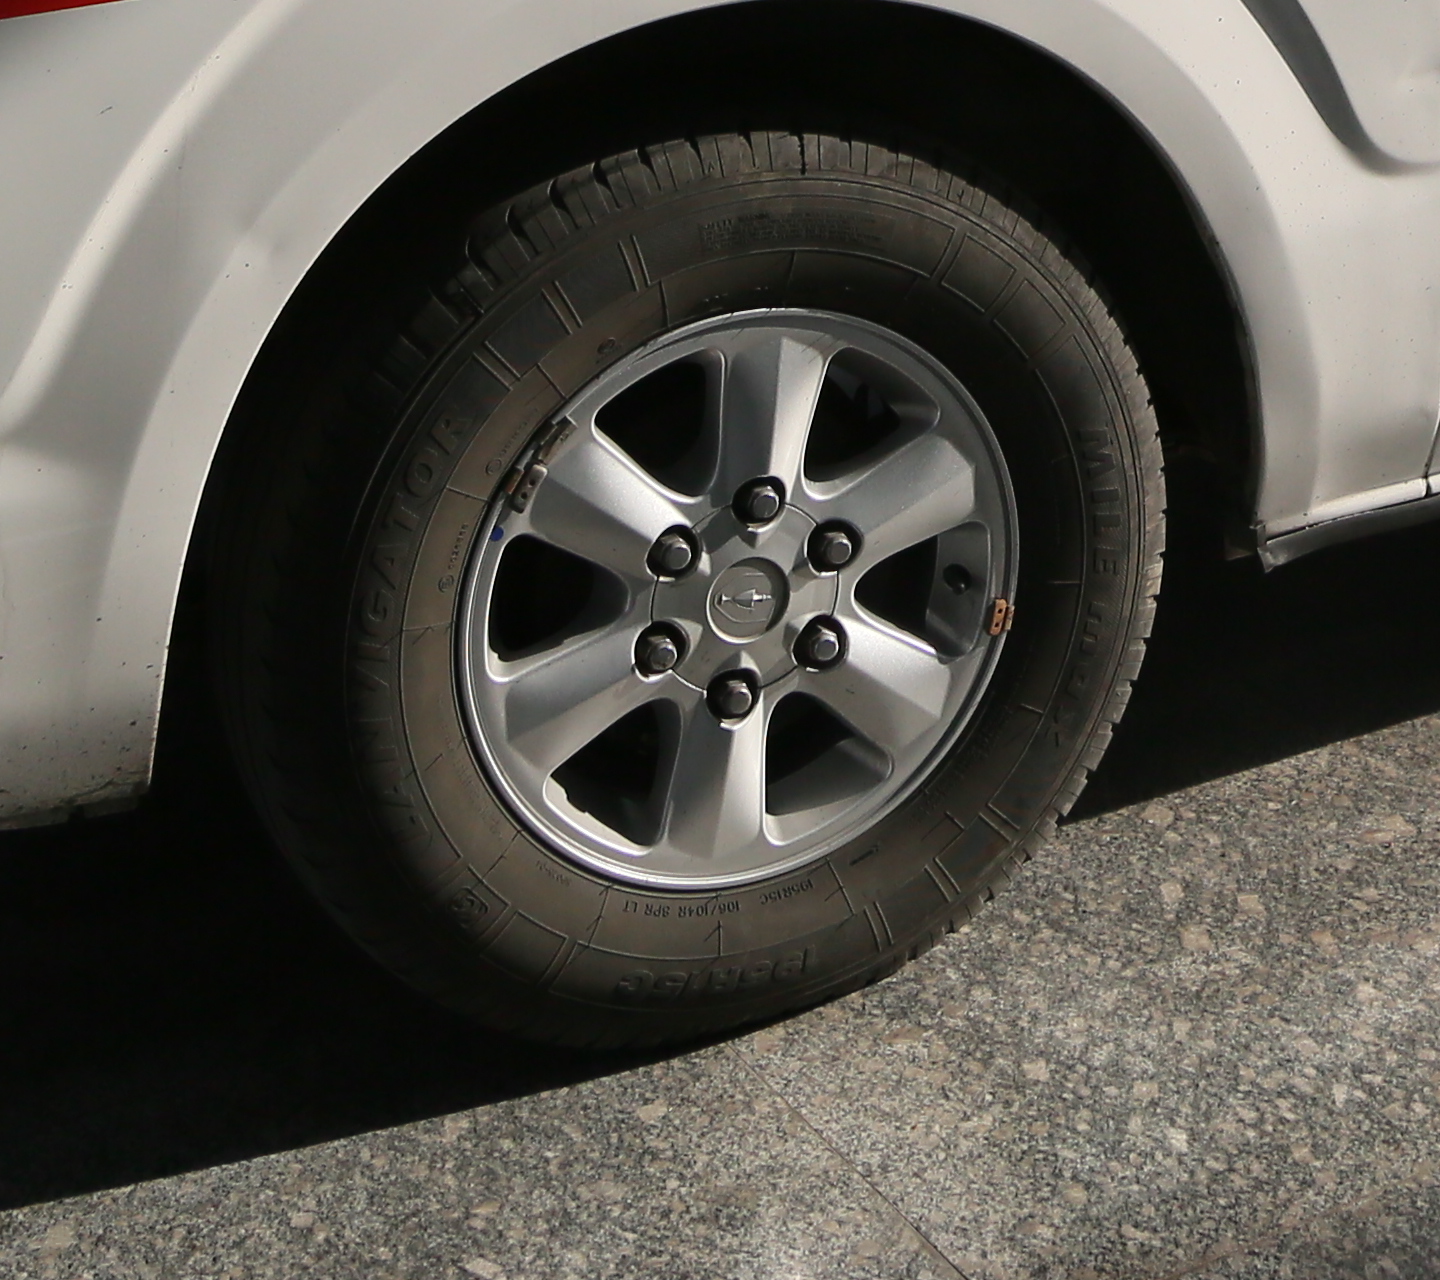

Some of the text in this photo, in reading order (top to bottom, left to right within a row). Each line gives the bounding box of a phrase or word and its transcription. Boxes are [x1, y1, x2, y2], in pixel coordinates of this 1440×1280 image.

[1078, 424, 1122, 577] MILE
[760, 878, 814, 906] 195R15C
[621, 899, 639, 914] LT
